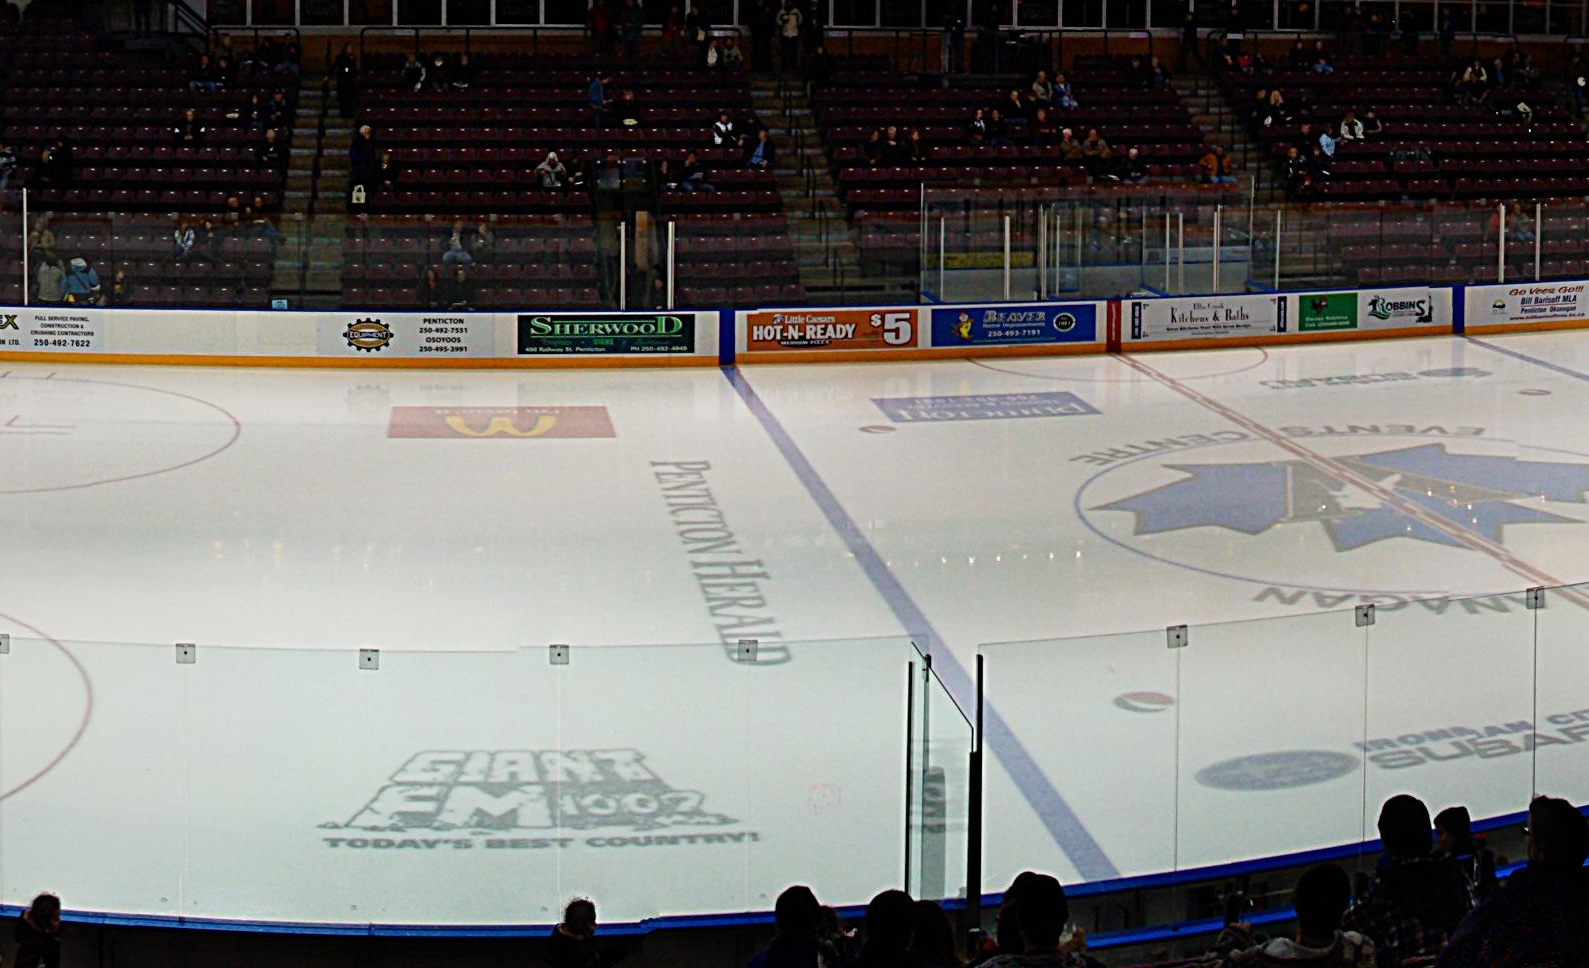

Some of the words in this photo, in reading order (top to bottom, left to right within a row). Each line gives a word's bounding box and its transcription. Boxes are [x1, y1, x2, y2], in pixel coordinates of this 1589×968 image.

[1509, 288, 1526, 296] Go
[1529, 287, 1555, 295] Vees
[1558, 285, 1584, 293] Go!!!
[1521, 296, 1532, 305] Bill
[1534, 295, 1561, 304] Barisoff
[1562, 294, 1577, 302] MLA
[784, 314, 805, 323] Little
[805, 314, 835, 323] Caesars
[983, 310, 1047, 323] BEAVER
[1170, 307, 1209, 324] Kitchens
[1212, 311, 1220, 322] &
[1225, 306, 1249, 322] Baths
[423, 317, 464, 325] PENTICTON
[530, 316, 683, 335] SHERWOOD
[348, 331, 389, 339] EQUIPMENT
[988, 329, 1041, 337] 250-493-7191
[33, 338, 91, 348] 250-492-7622
[419, 345, 468, 353] 250-495-3991
[650, 460, 742, 554] PENTICTON
[690, 560, 792, 666] HERALD
[389, 749, 665, 784] GIANT
[323, 836, 475, 849] TODAY'S
[485, 836, 573, 849] BEST
[585, 832, 761, 849] COUNTRY!
